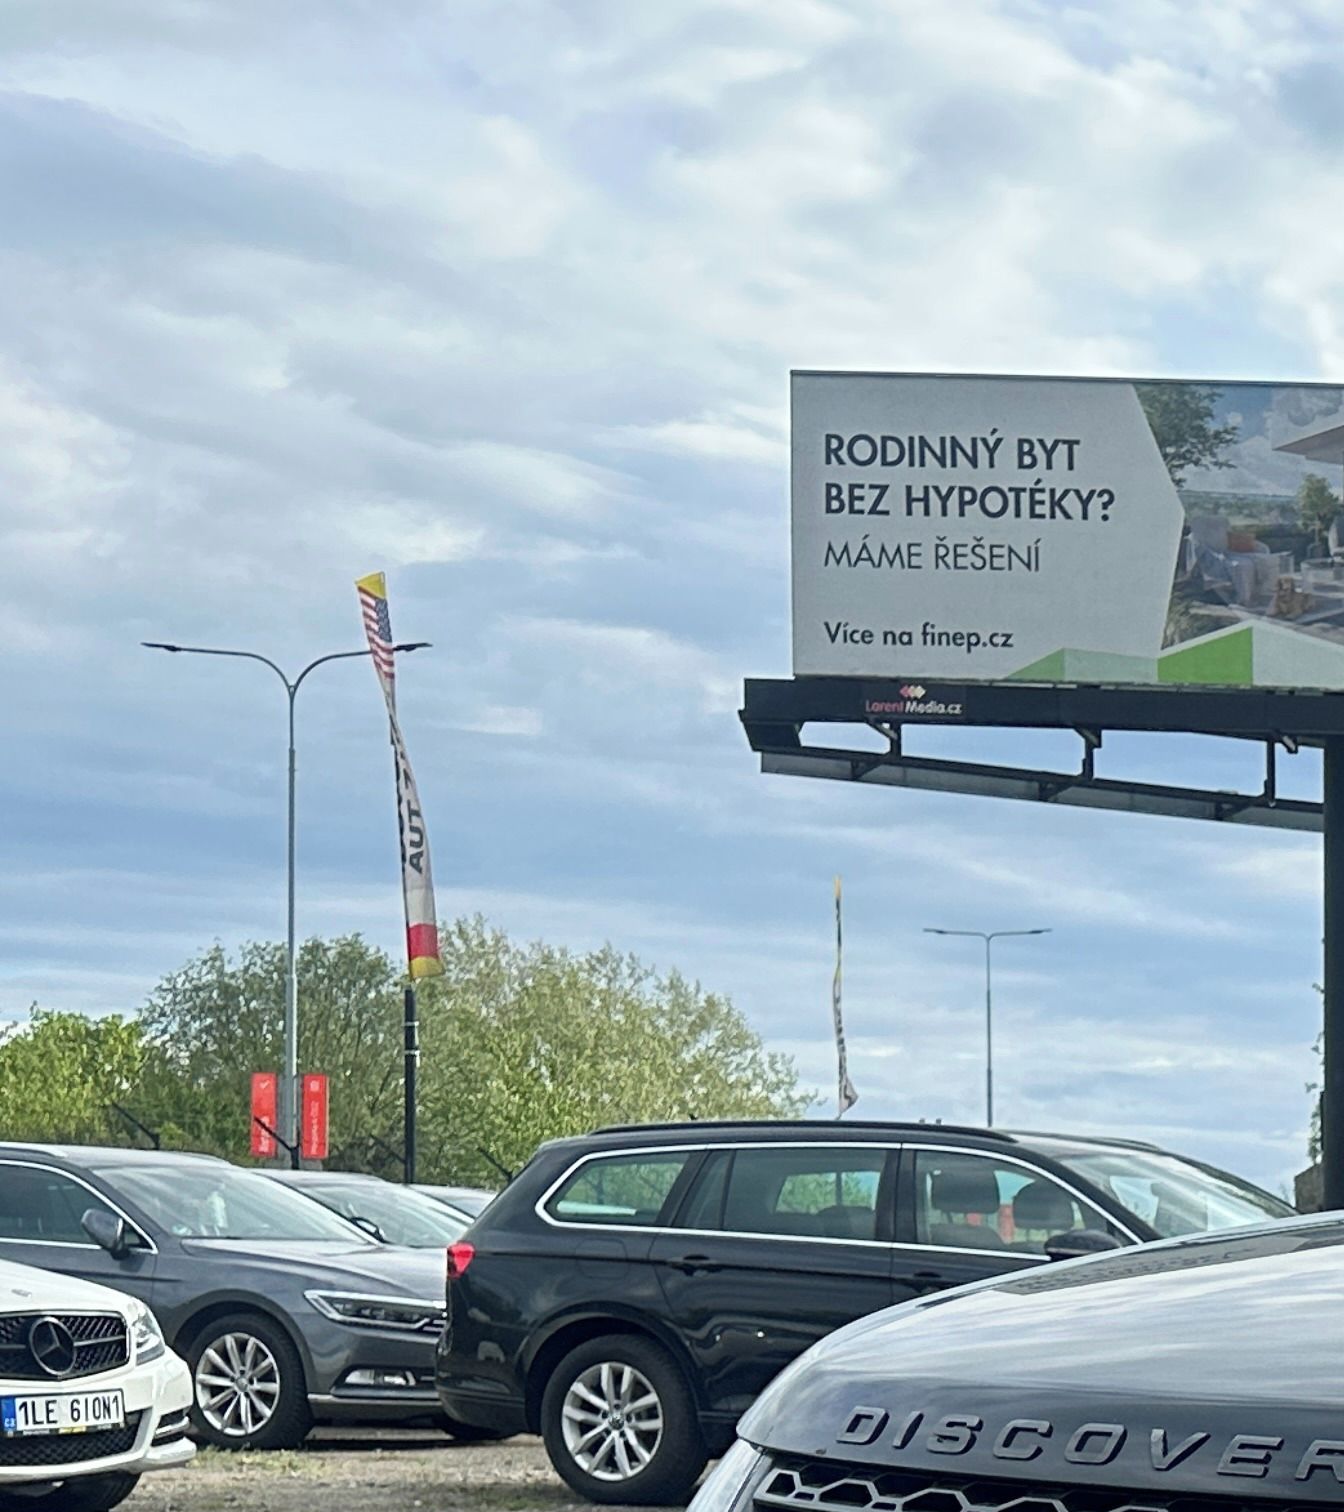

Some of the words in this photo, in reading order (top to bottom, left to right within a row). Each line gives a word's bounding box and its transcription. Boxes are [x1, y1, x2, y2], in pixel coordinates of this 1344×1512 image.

[824, 428, 1004, 469] RODINNÝ
[1017, 437, 1081, 471] BYT
[824, 482, 890, 516] BEZ
[905, 478, 1116, 522] HYPOTÉKY?
[824, 534, 923, 569] MÁME
[935, 535, 1042, 573] ŘEŠENÍ
[824, 621, 875, 645] Více
[882, 631, 913, 646] na
[921, 621, 1014, 653] finep.cz
[406, 799, 424, 875] AUT
[19, 1400, 58, 1426] 1LE
